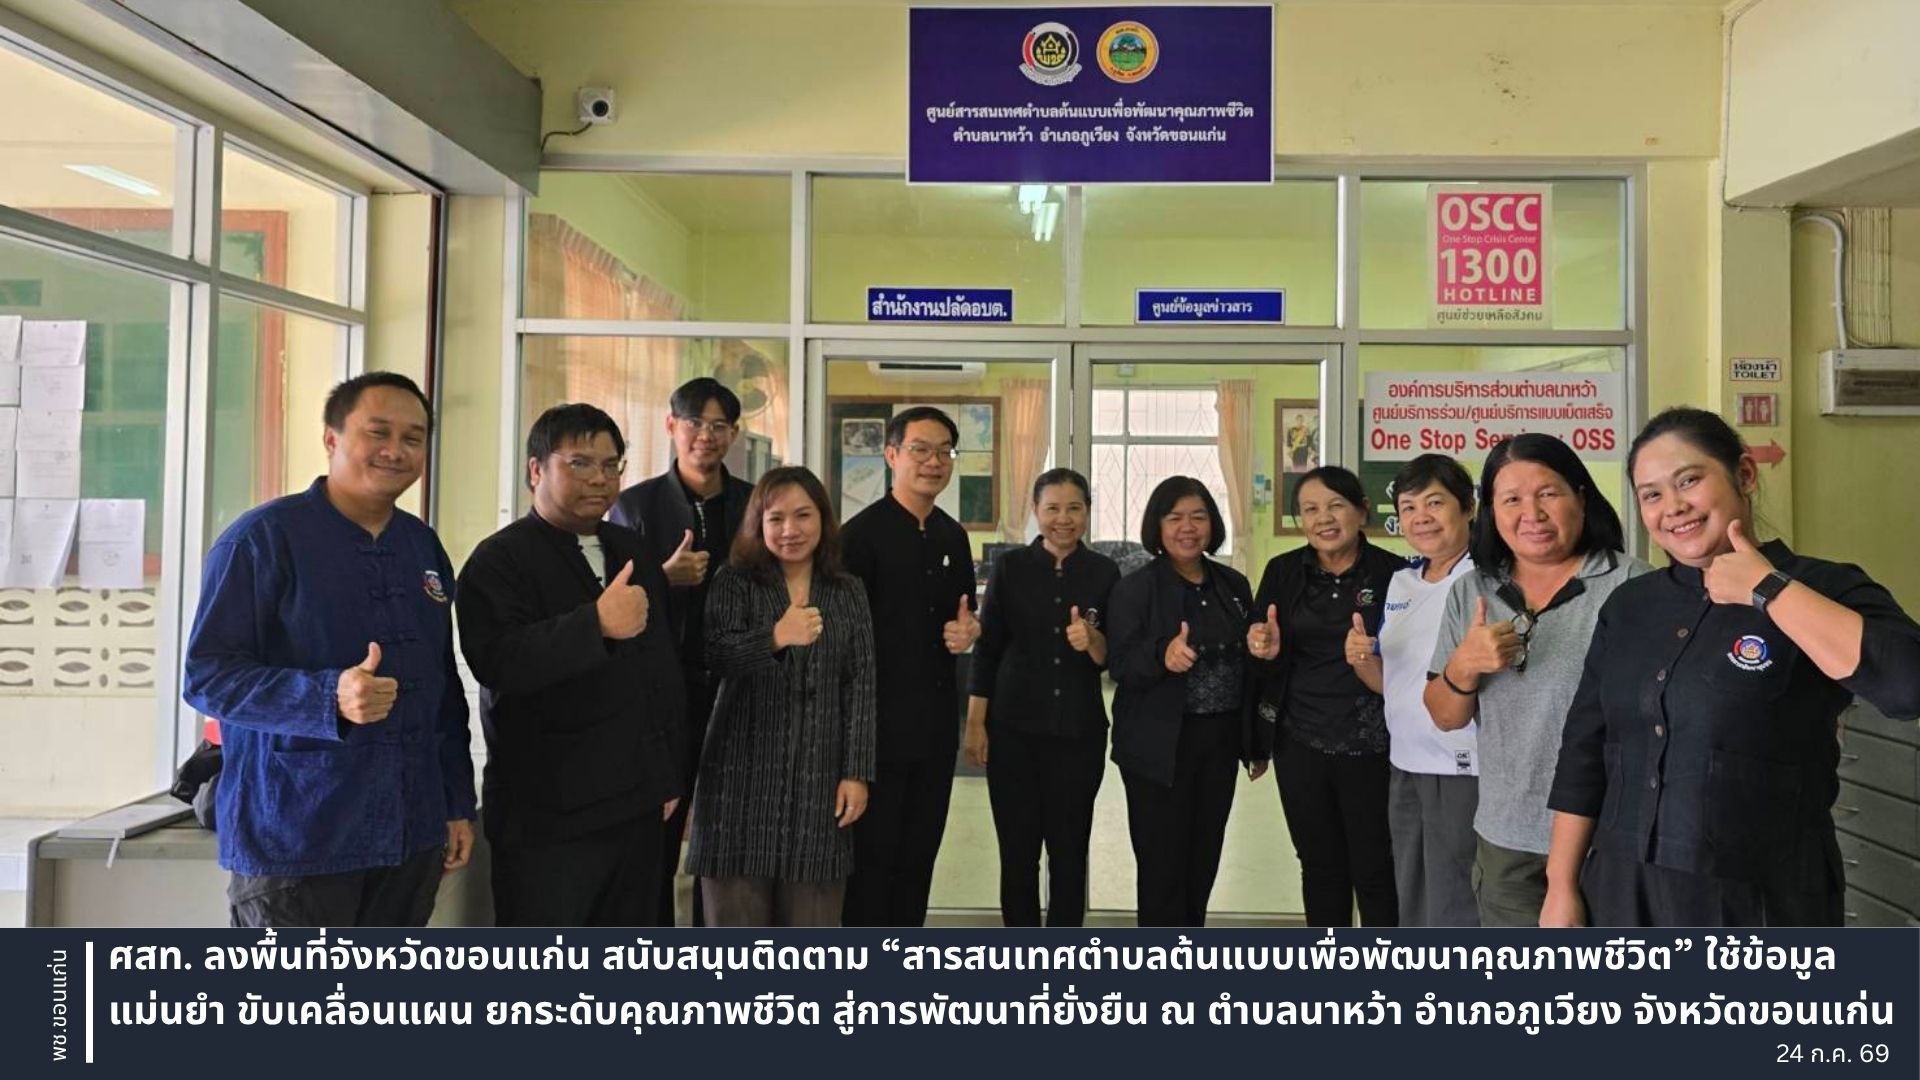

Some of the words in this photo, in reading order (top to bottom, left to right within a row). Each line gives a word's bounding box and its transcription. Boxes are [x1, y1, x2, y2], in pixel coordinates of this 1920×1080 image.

[926, 98, 1254, 123] ศูนย์สารสนเทศตำบลต้นแบบเพื่อพัฒนาคุณภาพชีวิต
[953, 127, 1033, 143] ตำบลนาหว้า
[1040, 128, 1119, 147] อำเภอภูเวียง
[1125, 126, 1227, 143] จังหวัดขอนแก่น
[1441, 196, 1538, 232] OSCC
[1443, 235, 1461, 244] One
[1462, 235, 1482, 246] Stop
[1484, 235, 1507, 244] Crisis
[1508, 235, 1537, 244] Center
[1440, 248, 1537, 285] 1300
[872, 292, 1008, 317] สำนักงานปลัดอบต.
[1443, 287, 1537, 302] HOTLINE
[1152, 297, 1254, 318] ศูนย์ข้อมูลข่าวสาร
[1437, 308, 1543, 324] ศูนย์ช่วยเหลือสังคม
[1733, 359, 1777, 371] ห้องน้ำ
[1733, 371, 1776, 379] TOILET
[1388, 380, 1597, 398] องค์การบริหารส่วนตำบลนาหว้า
[1372, 403, 1614, 424] ศูนย์บริการร่วม/ศูนย์บริการแบบเบ็ดเสร็จ
[1371, 428, 1411, 450] One
[1420, 428, 1466, 454] Stop
[1572, 428, 1615, 450] OSS
